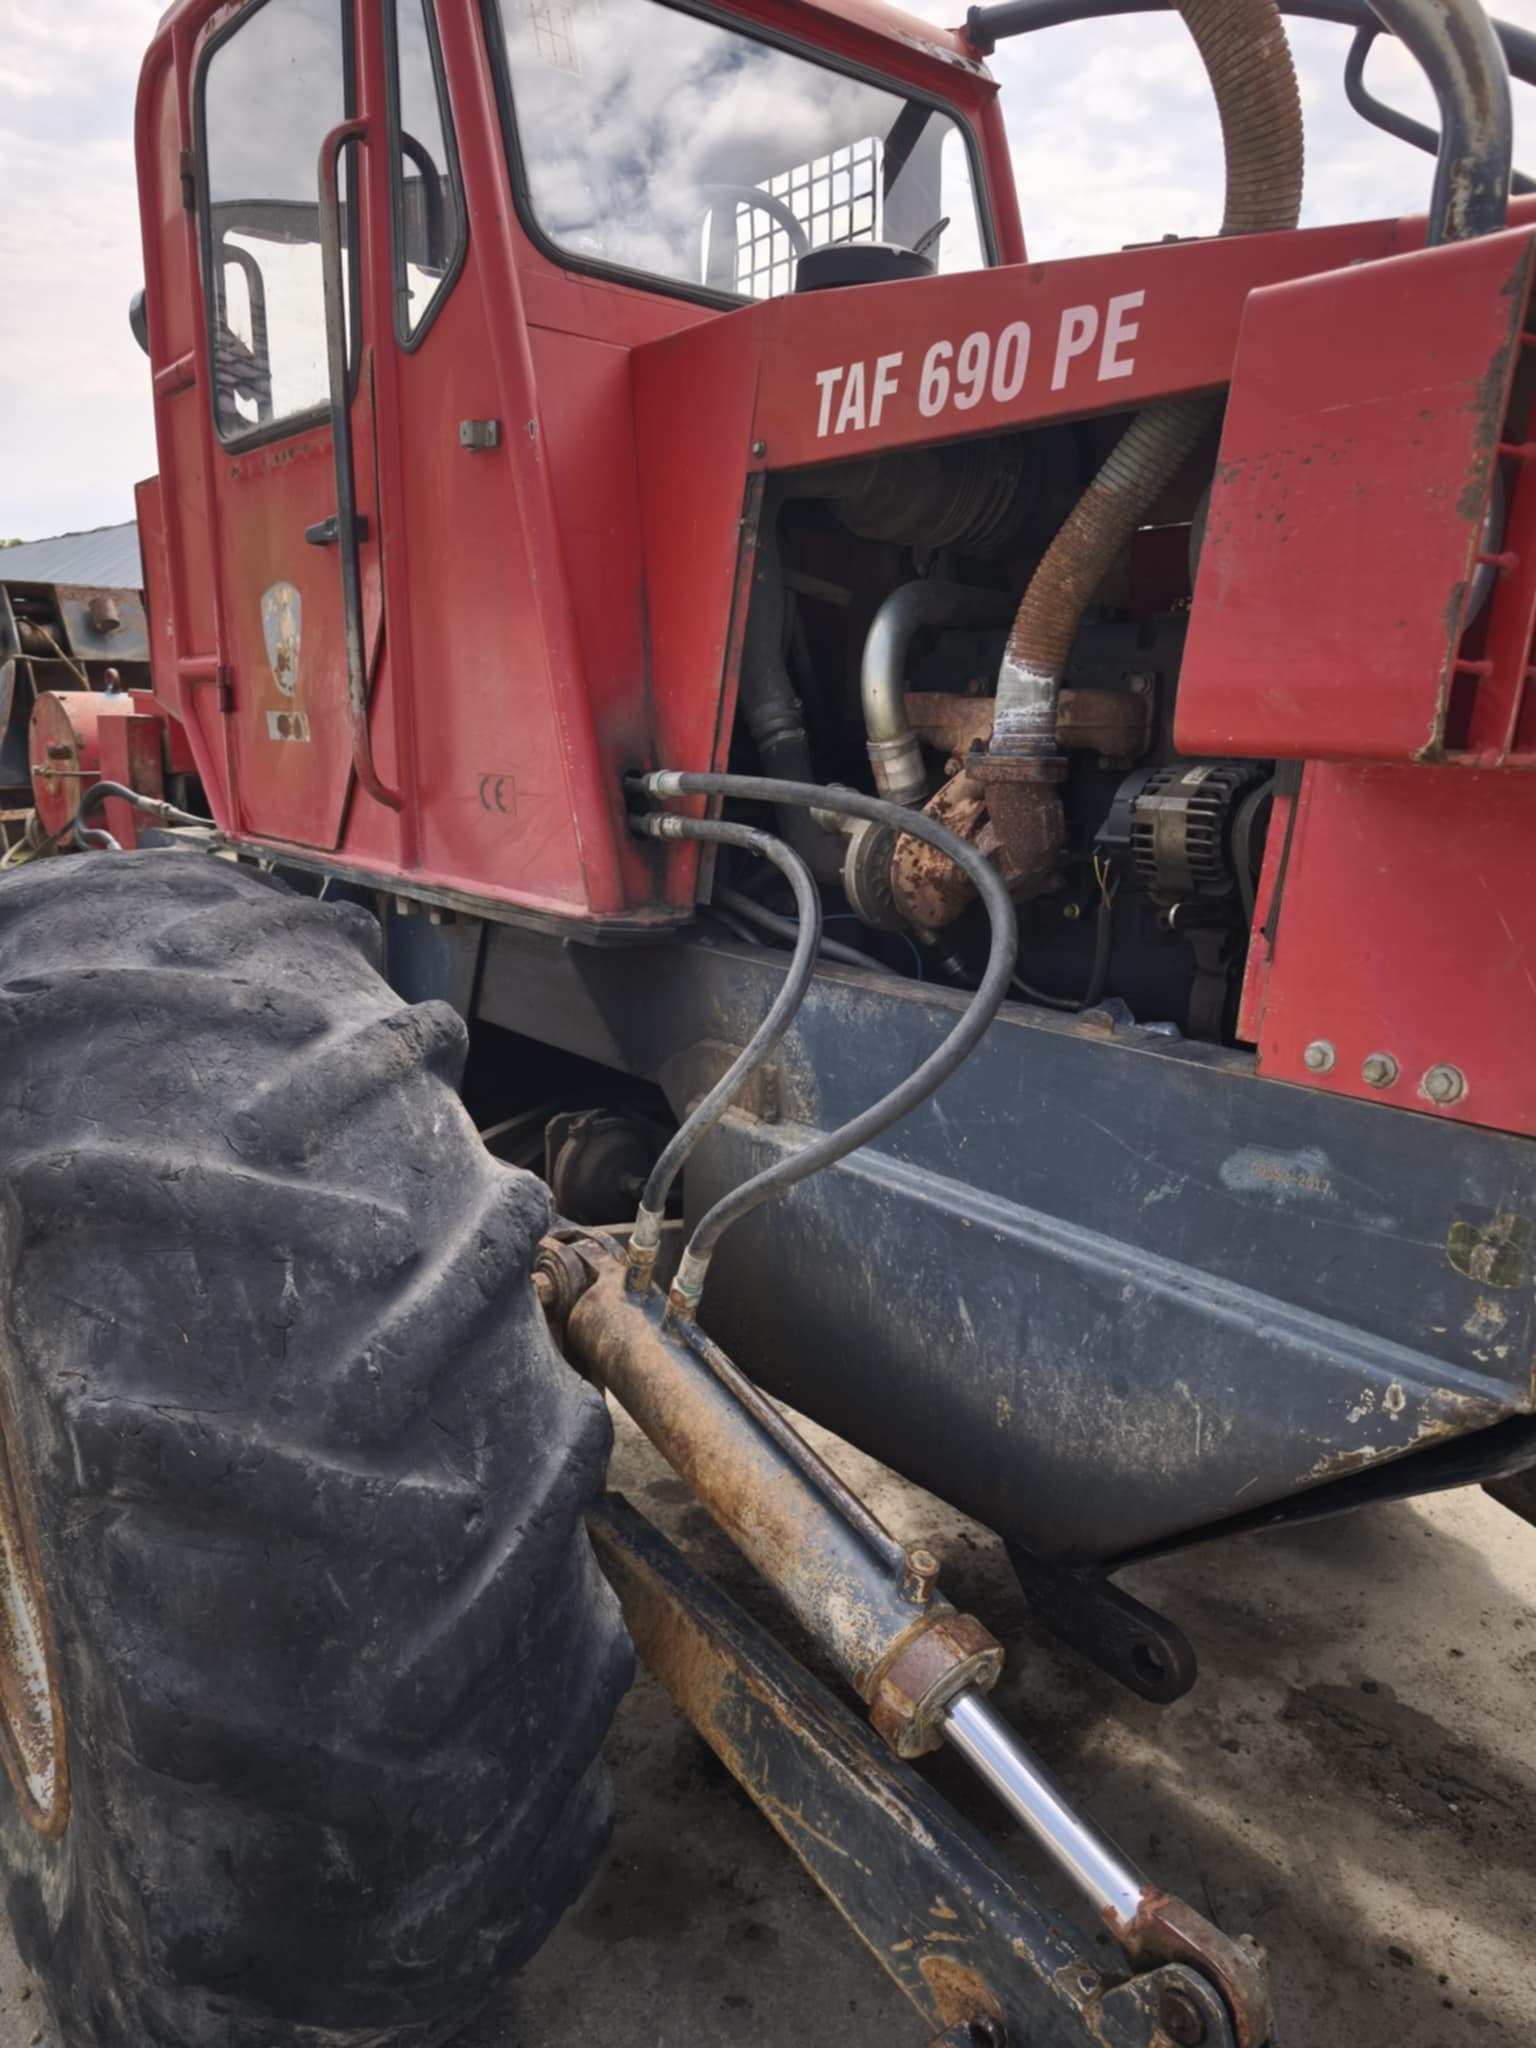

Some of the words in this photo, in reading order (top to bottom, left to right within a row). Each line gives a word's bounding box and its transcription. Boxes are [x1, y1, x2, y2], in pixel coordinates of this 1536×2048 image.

[815, 351, 903, 438] TAF
[917, 320, 1031, 418] 690
[1049, 289, 1146, 392] PE
